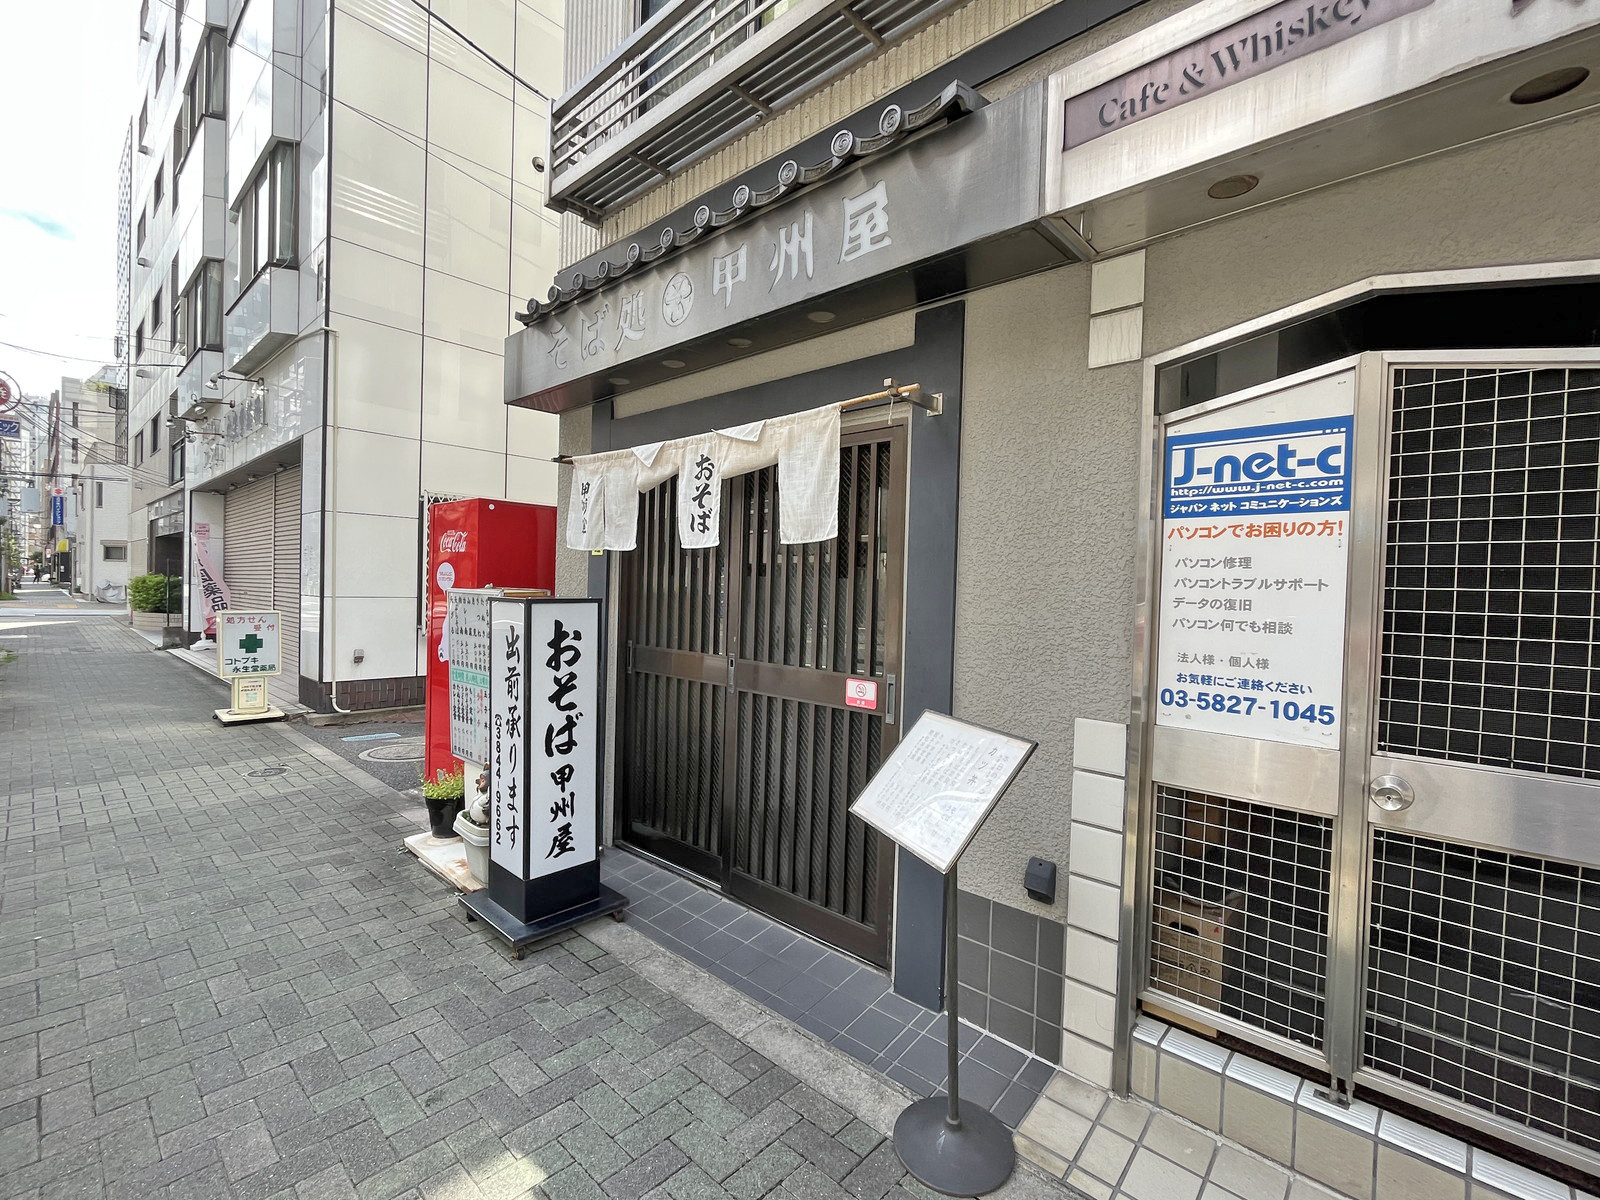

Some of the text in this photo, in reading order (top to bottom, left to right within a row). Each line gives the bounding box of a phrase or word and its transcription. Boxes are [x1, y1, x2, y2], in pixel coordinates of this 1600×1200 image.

[1098, 82, 1169, 128] Cafe
[1179, 63, 1205, 95] &
[547, 180, 893, 370] そば処 甲州屋
[1173, 443, 1342, 486] J-net-c
[690, 453, 715, 534] おそば
[1170, 479, 1344, 497] http://www.j-net-c.com
[1170, 495, 1342, 514] ジャパン ネット コミュニケーションズ
[1175, 556, 1252, 569] パソコン修理
[1174, 577, 1329, 592] パソコントラブルサポート
[1172, 597, 1252, 612] データの復旧
[226, 616, 267, 624] 処方せん
[1172, 617, 1293, 635] パソコン何でも相談
[225, 657, 259, 665] コトブキ
[232, 664, 276, 674] 永生堂薬局
[1176, 672, 1312, 695] お気軽にご連絡ください
[1160, 688, 1335, 725] 03-5827-1045
[505, 625, 522, 850] 出前承ります
[966, 747, 999, 786] カツ丼
